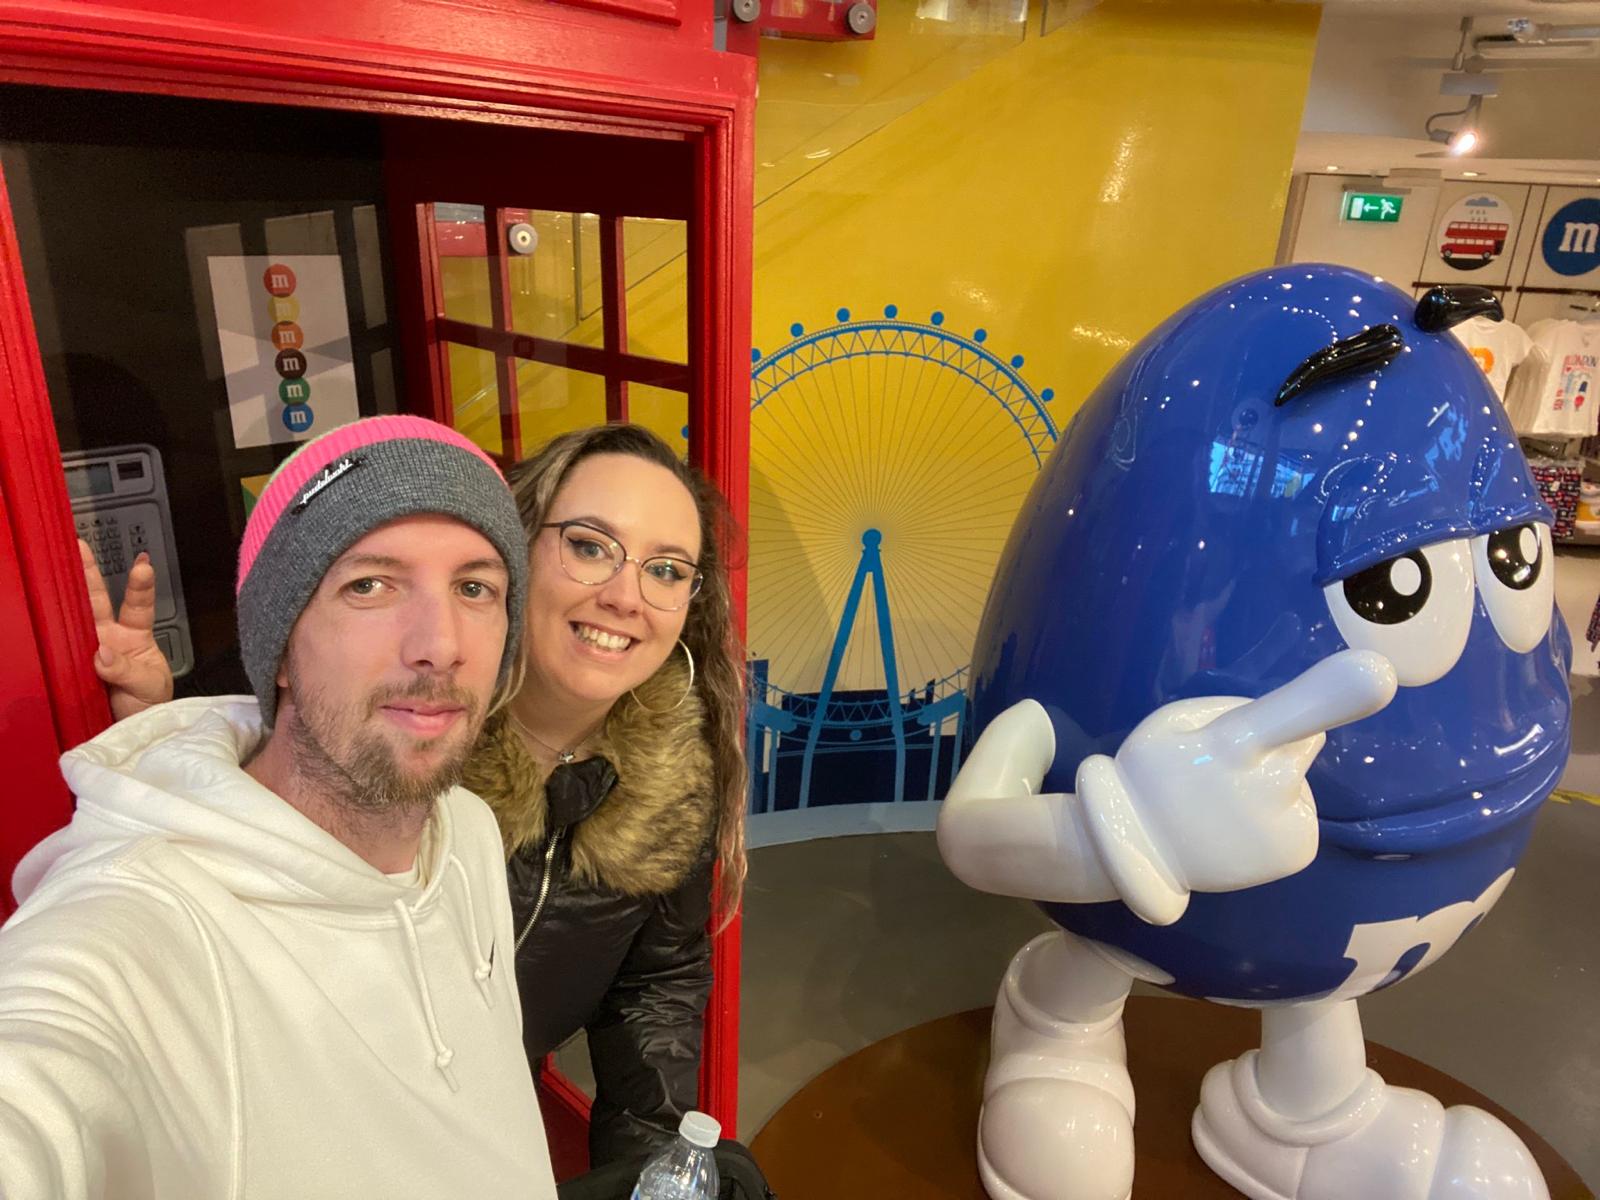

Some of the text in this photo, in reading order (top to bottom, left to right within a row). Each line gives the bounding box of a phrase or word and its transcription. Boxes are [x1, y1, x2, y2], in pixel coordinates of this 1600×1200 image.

[1558, 222, 1599, 253] m
[271, 274, 290, 288] m
[278, 331, 297, 344] m
[282, 357, 301, 371] m
[286, 384, 304, 398] m
[290, 410, 308, 424] m
